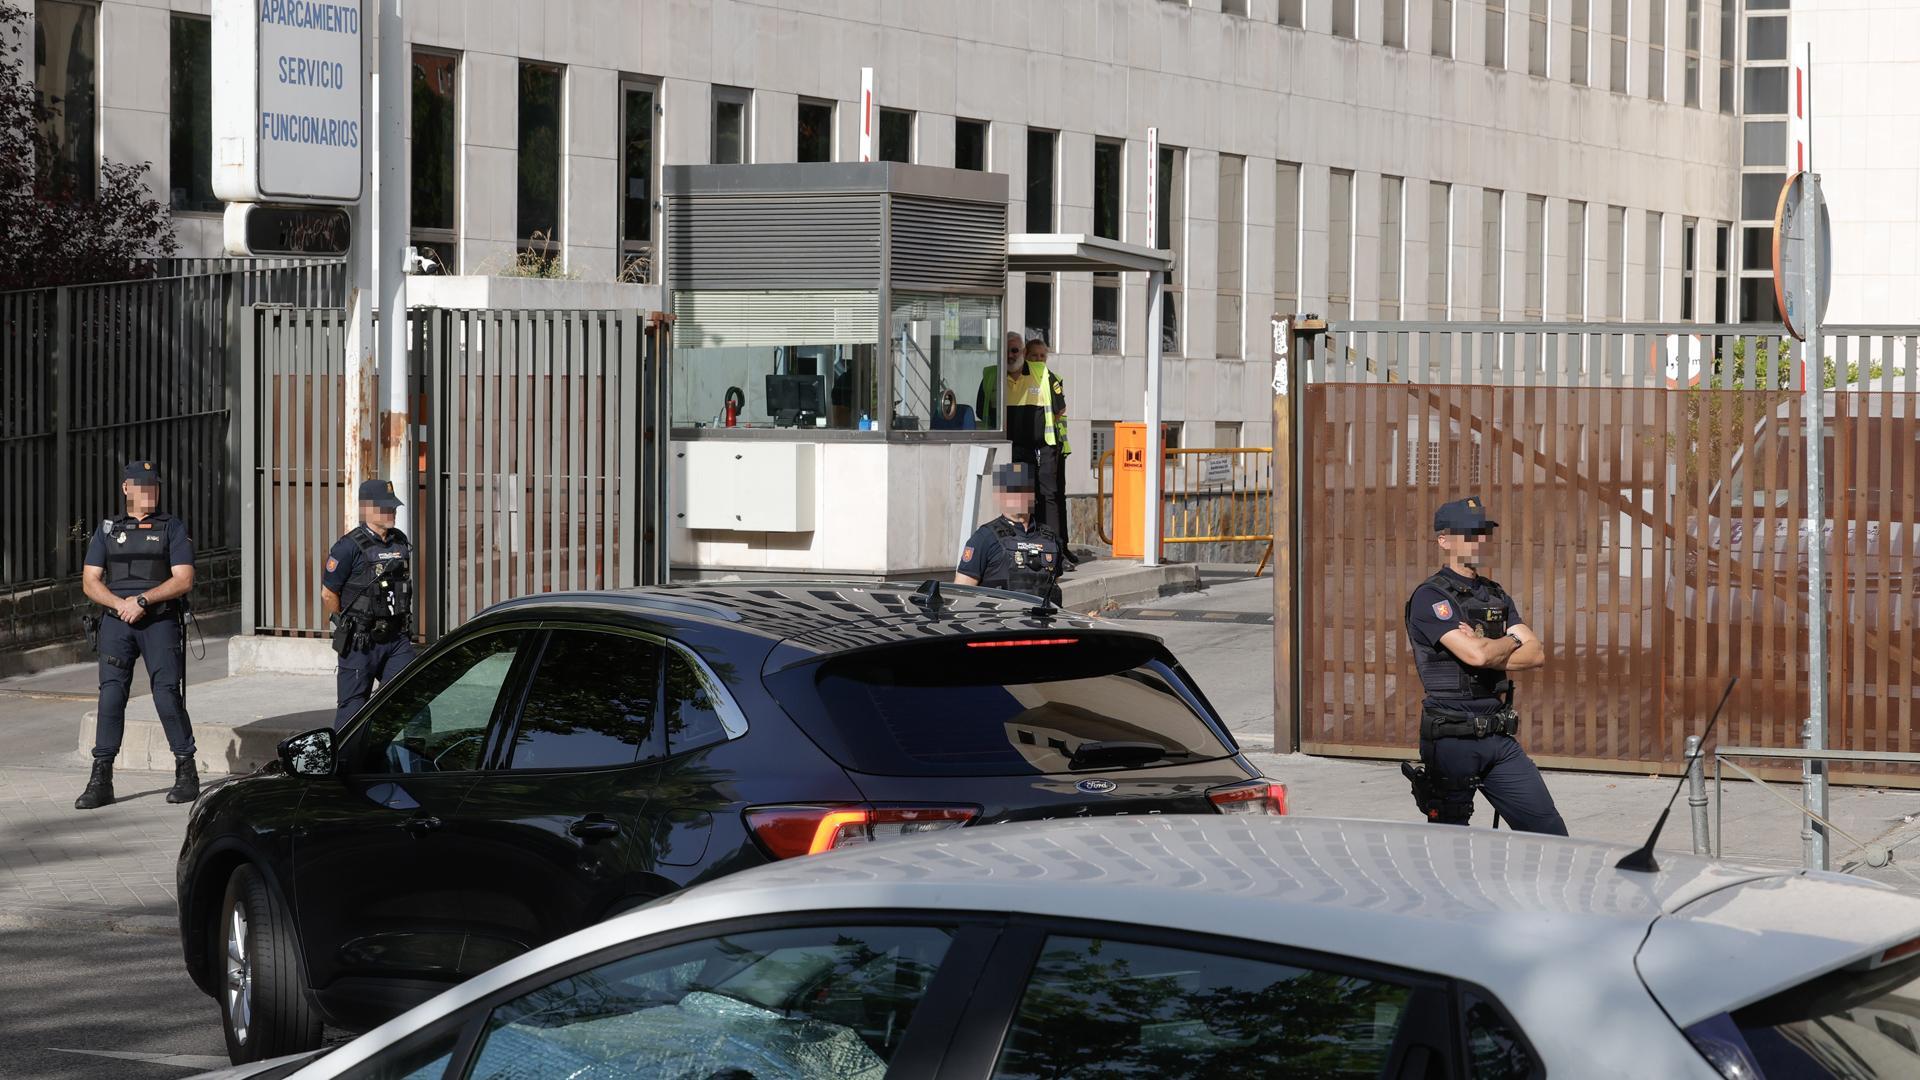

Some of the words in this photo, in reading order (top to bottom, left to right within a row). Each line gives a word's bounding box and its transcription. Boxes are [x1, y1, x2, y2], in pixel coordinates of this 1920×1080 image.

[261, 0, 358, 34] APARCAMIENTO
[278, 56, 343, 90] SERVICIO
[262, 112, 358, 148] FUNCIONARIOS
